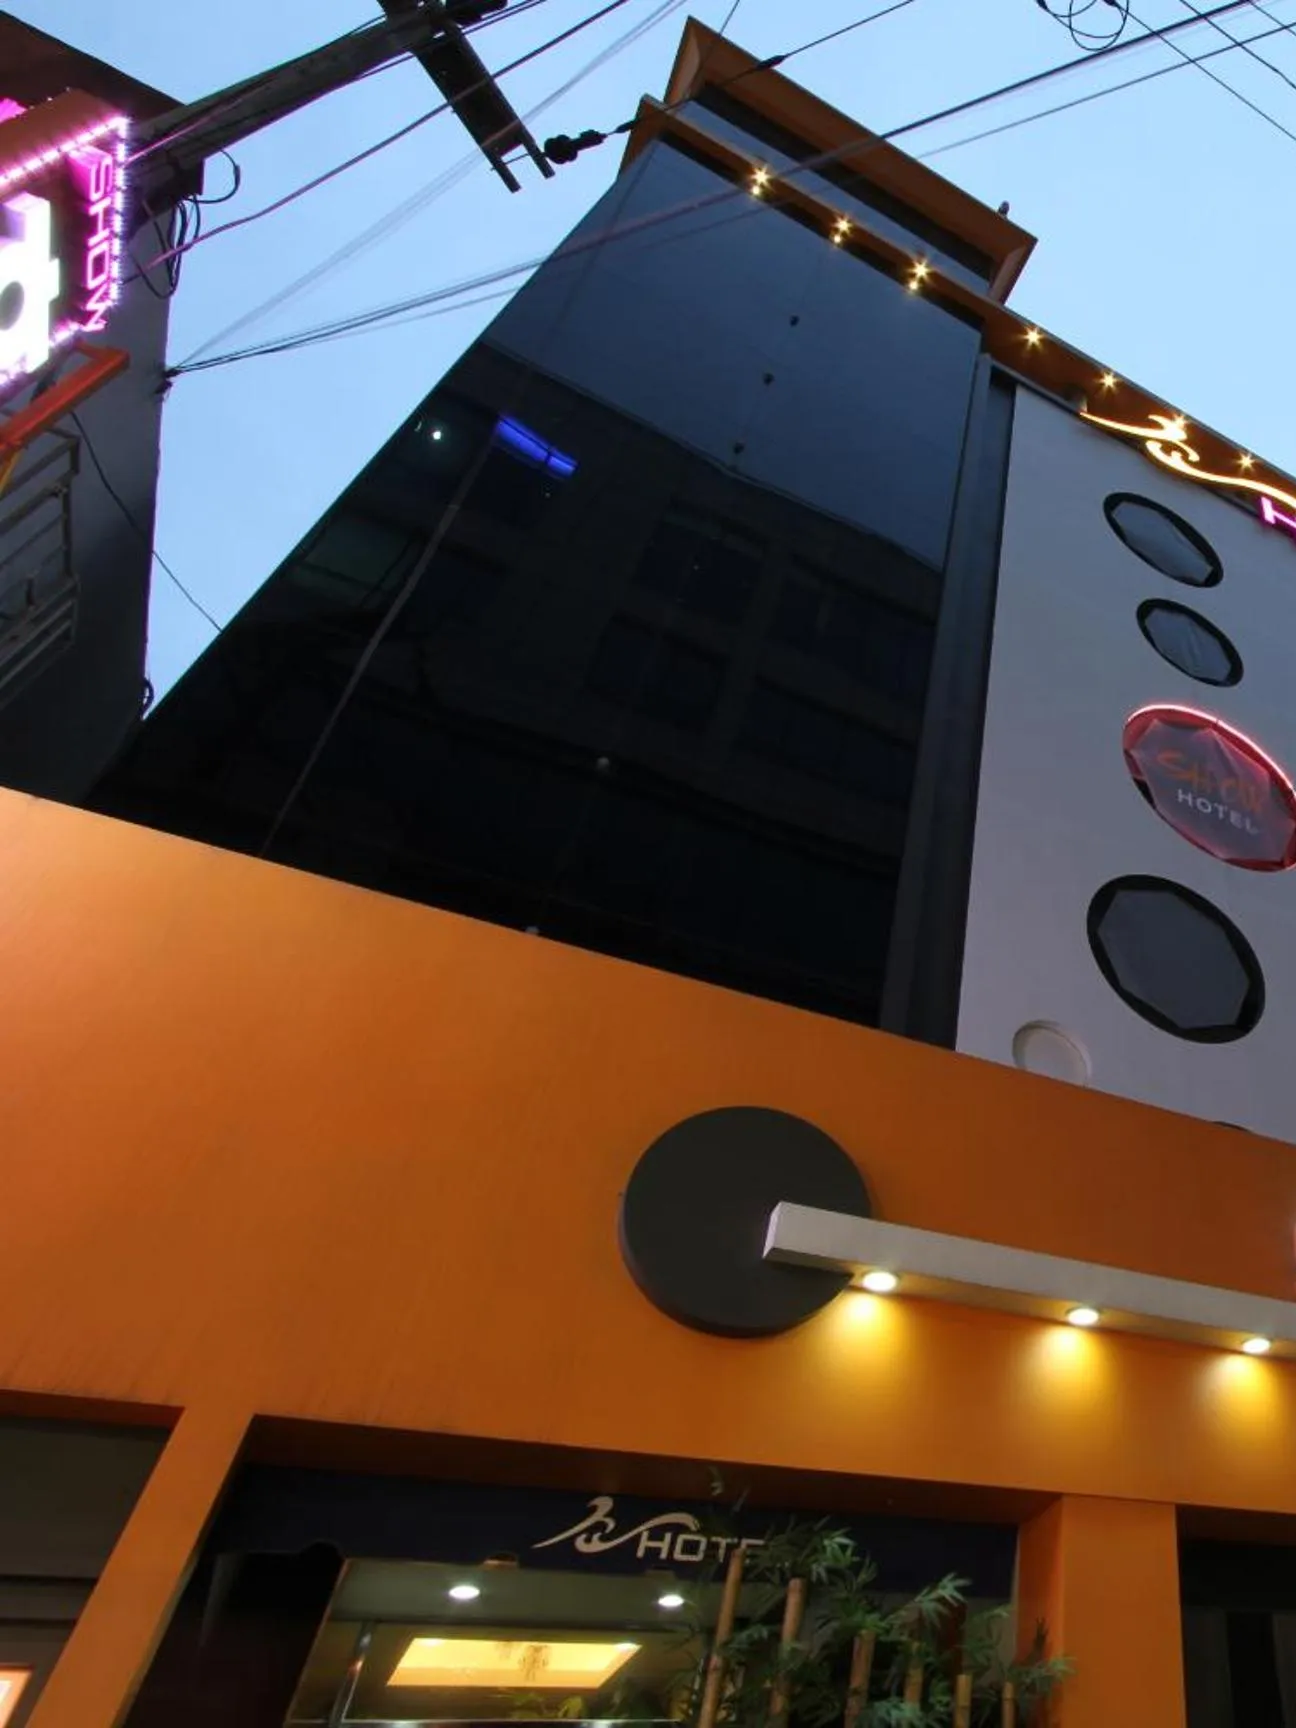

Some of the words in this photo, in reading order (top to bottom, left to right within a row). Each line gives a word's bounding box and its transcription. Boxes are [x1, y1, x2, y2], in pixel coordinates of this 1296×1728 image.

[86, 152, 113, 332] SHOW
[1178, 788, 1260, 835] HOTEL
[636, 1530, 790, 1568] HOT
